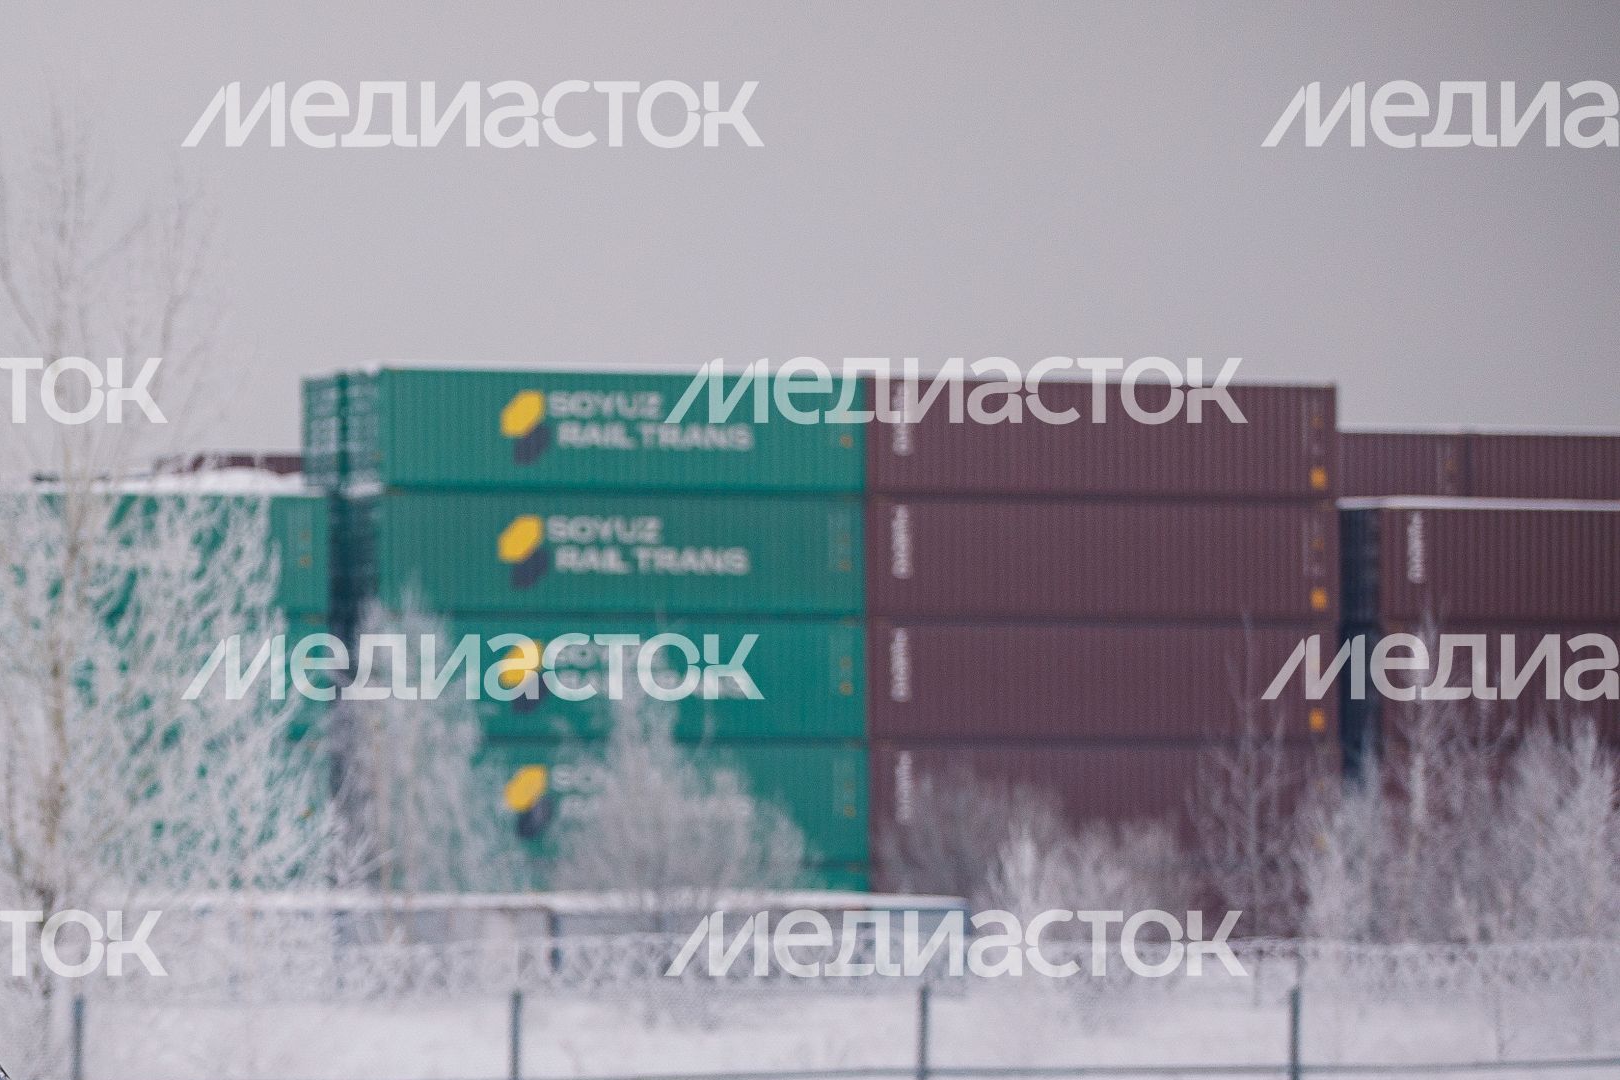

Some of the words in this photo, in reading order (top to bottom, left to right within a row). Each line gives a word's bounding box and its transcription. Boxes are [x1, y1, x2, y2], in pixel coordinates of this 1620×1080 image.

[547, 391, 663, 419] SOYUZ
[556, 422, 634, 449] RAIL
[635, 422, 754, 450] TRANS
[547, 515, 663, 544] SOYUZ
[555, 546, 630, 574] RAIL
[633, 547, 750, 576] TRANS
